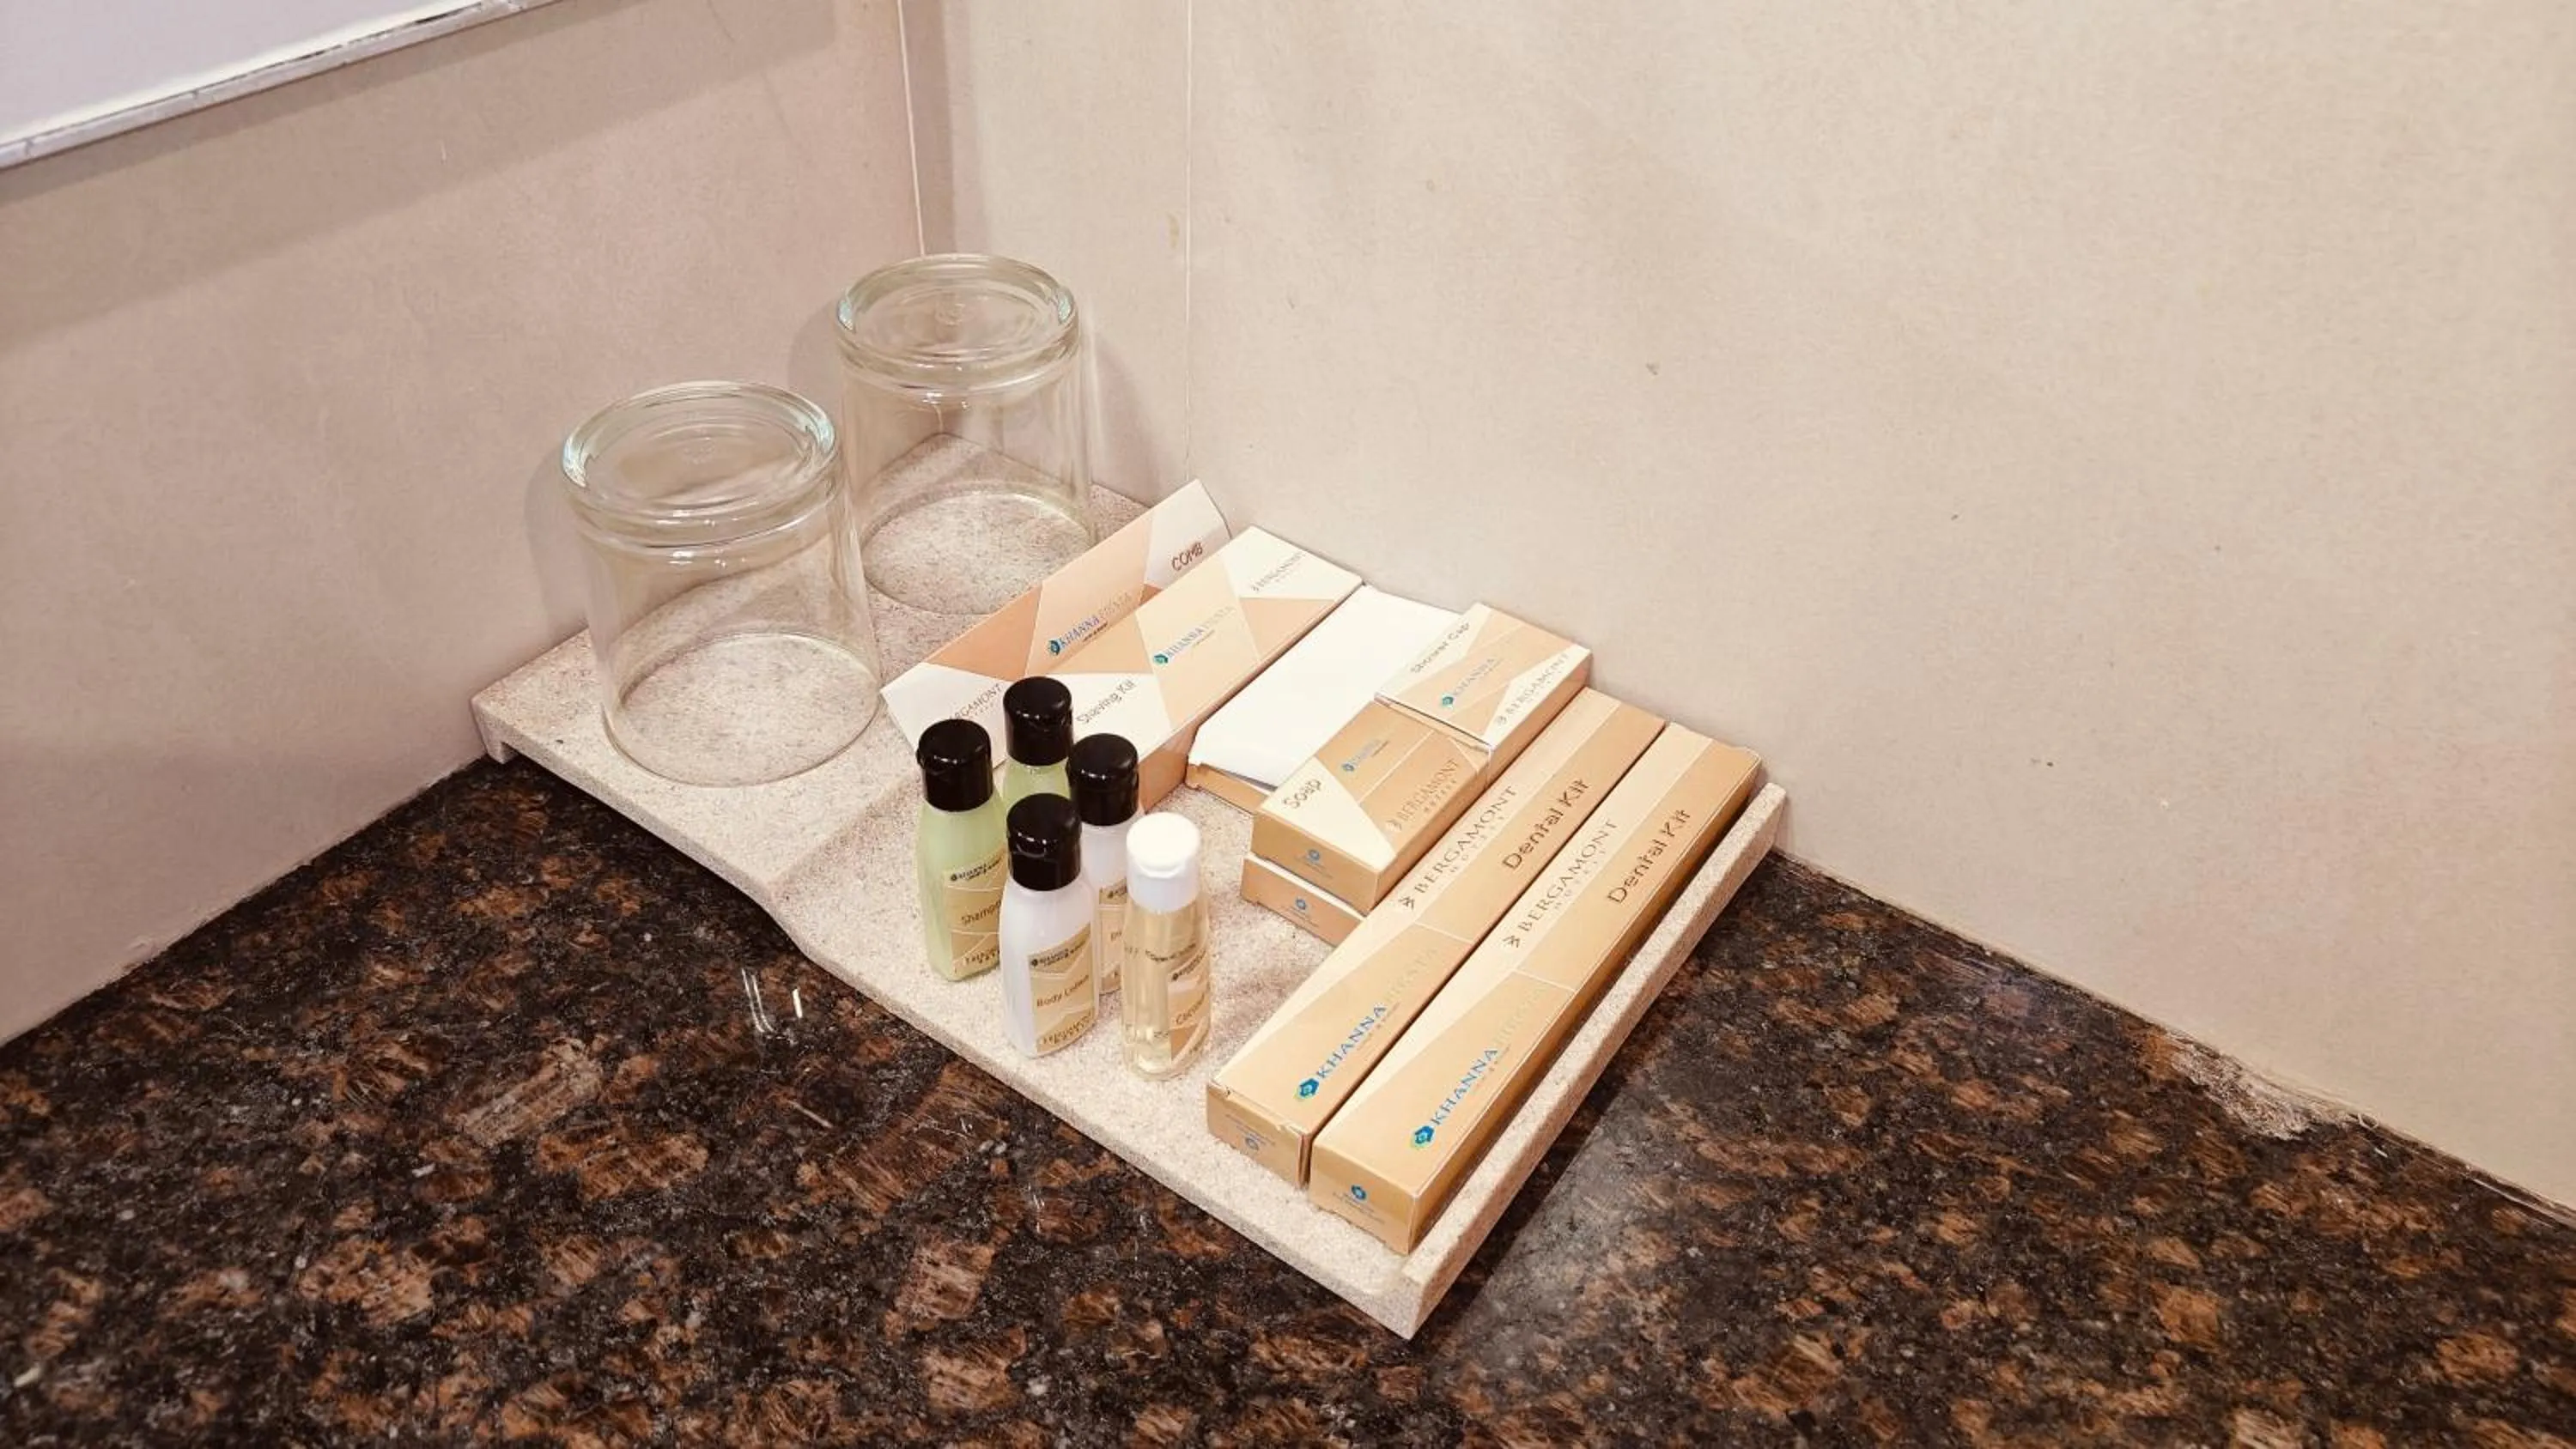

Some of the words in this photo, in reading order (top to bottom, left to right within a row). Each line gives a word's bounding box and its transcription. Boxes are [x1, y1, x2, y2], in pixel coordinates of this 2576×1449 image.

[1170, 541, 1205, 572] COMB
[1059, 615, 1100, 650] KHANNA
[1411, 640, 1449, 674] Shower
[1447, 622, 1470, 642] Cap
[949, 682, 1004, 719] RGAMONT
[1075, 692, 1123, 726] Shaving
[1116, 678, 1137, 695] Kit
[1505, 652, 1569, 714] BERGAMONT
[1282, 778, 1322, 810] Soap
[1397, 758, 1459, 821] BERGAMONT
[1414, 785, 1519, 894] BERGAMONT
[1503, 807, 1564, 870] Dental
[1558, 778, 1590, 809] Kit
[1518, 818, 1619, 932] BERGAMONT
[1607, 840, 1668, 904] Dental
[1661, 809, 1692, 840] Kit
[961, 899, 1001, 925] Shampo
[1036, 992, 1063, 1008] Body
[1315, 1003, 1388, 1080] KHANNA
[1430, 1046, 1499, 1126] KHANNA
